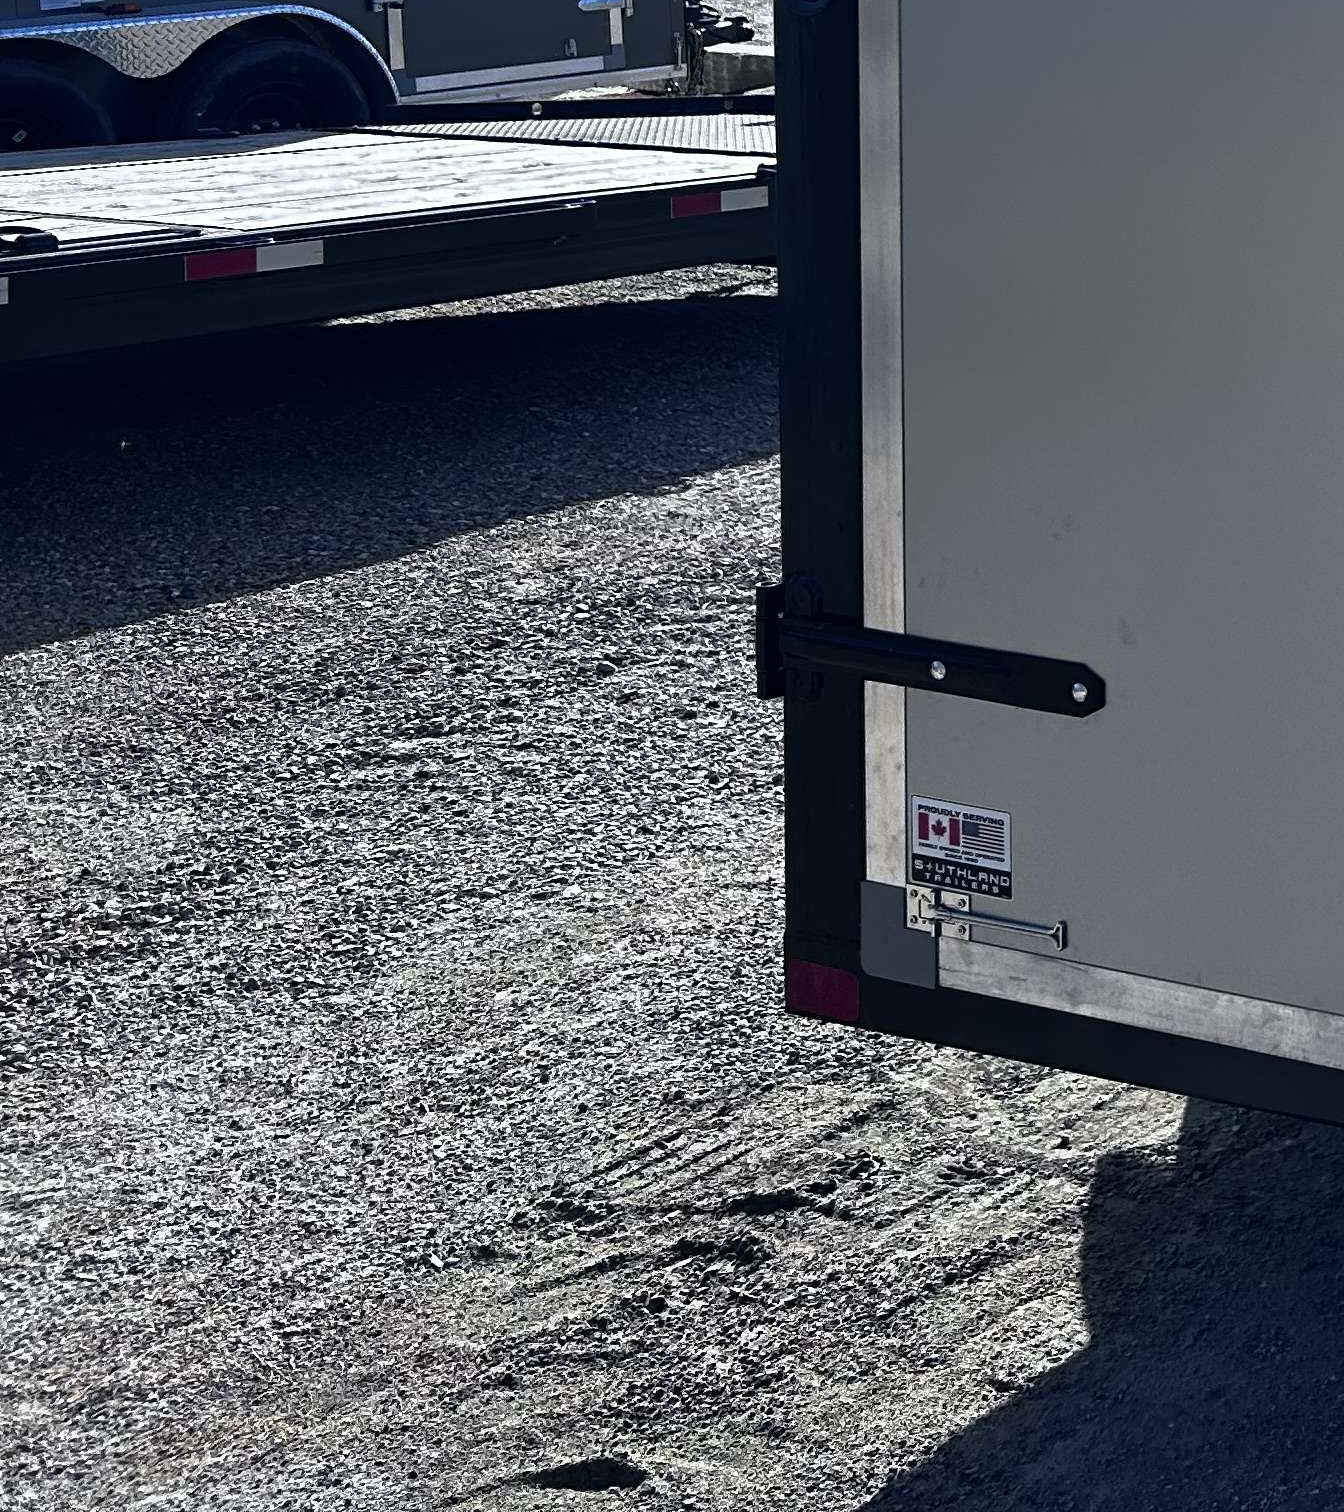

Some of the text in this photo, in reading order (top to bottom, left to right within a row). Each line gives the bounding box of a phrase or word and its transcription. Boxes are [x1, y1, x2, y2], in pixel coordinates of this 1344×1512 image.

[918, 804, 1005, 826] PROUDLY SERVING
[925, 872, 1000, 894] TRAILERS
